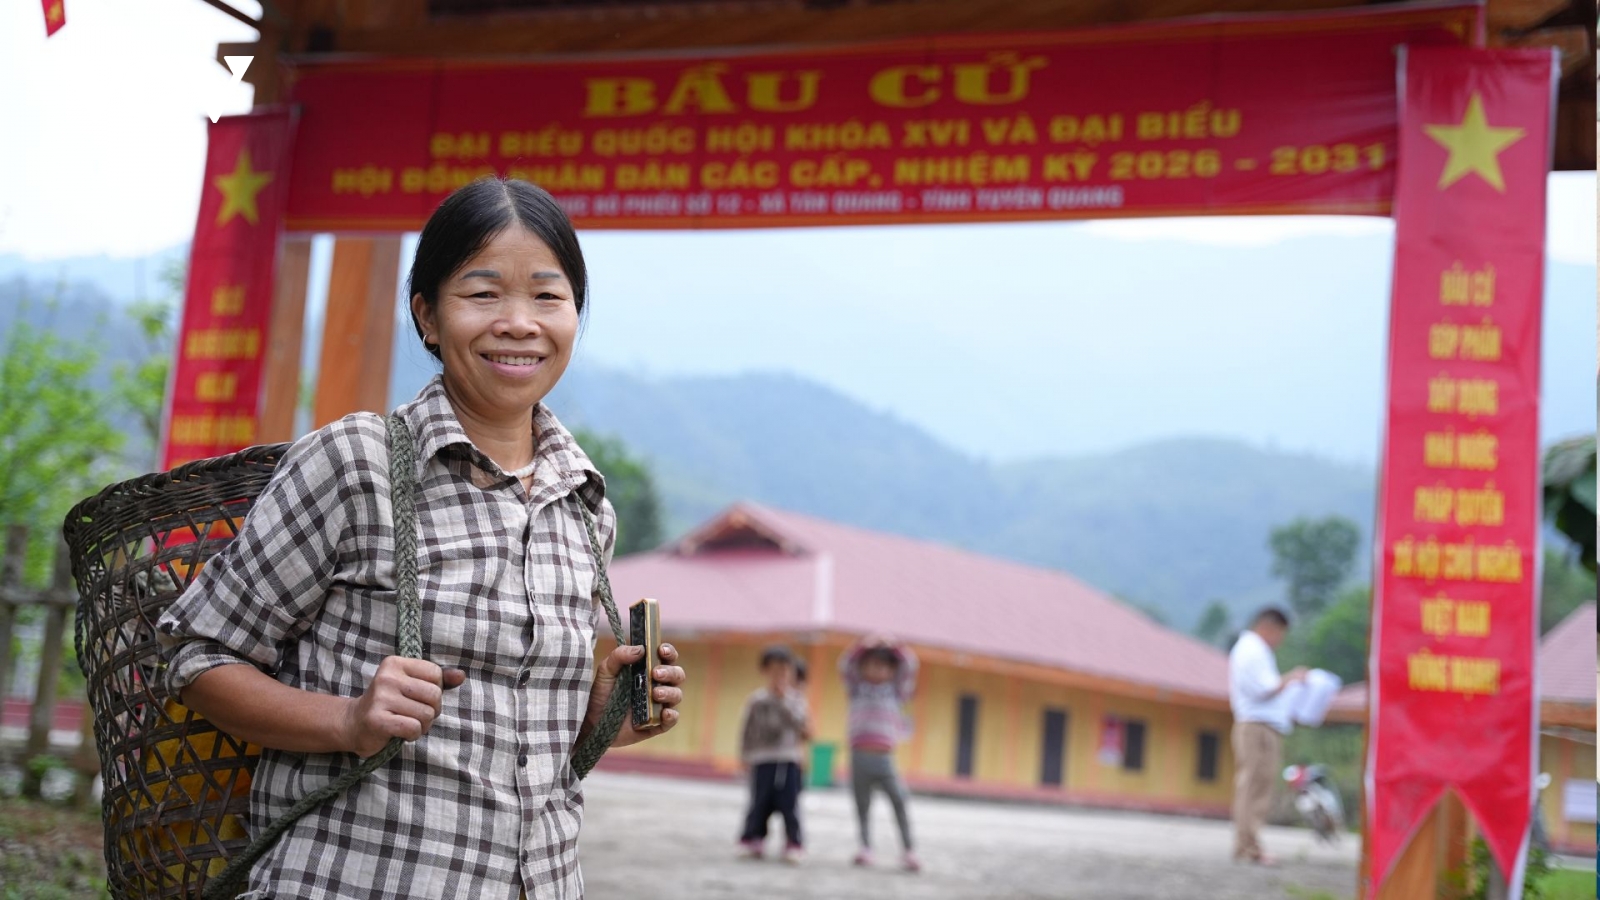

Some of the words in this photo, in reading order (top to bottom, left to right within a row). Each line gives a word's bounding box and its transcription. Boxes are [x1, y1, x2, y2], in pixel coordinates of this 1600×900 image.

[584, 63, 822, 117] BẦU
[868, 53, 1048, 107] CỬ
[430, 132, 490, 161] ĐẠI
[501, 126, 583, 157] BIỂU
[592, 122, 695, 155] QUỐC
[706, 123, 774, 155] HỘI
[785, 117, 892, 150] KHÓA
[904, 117, 969, 146] XVI
[983, 112, 1037, 144] VÀ
[1049, 113, 1123, 147] ĐẠI
[1136, 100, 1242, 140] BIỂU
[331, 163, 392, 197] HỘI
[614, 159, 692, 190] DÂN
[702, 154, 780, 189] CÁC
[895, 151, 1030, 187] NHIỆM
[1043, 148, 1100, 180] KỲ
[1109, 149, 1221, 180] 2026
[1270, 142, 1386, 175] 2031
